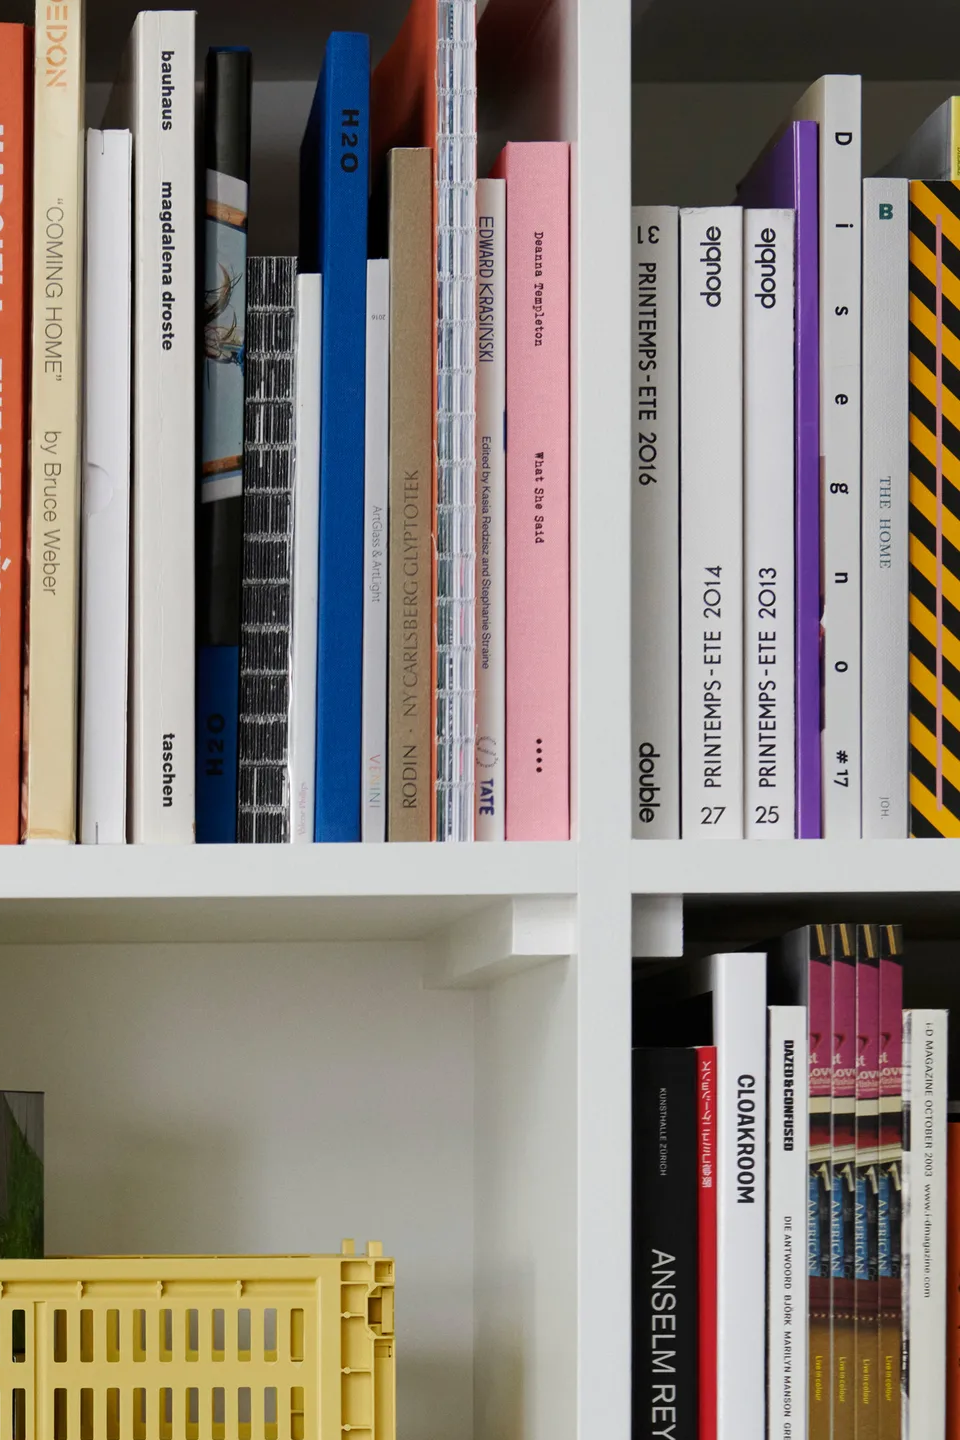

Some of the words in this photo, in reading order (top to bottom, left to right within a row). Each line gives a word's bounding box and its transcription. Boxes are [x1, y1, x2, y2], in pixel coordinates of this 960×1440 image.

[162, 51, 175, 131] bauhaus
[341, 109, 360, 173] H2O
[159, 182, 175, 286] magdalena
[479, 217, 494, 278] EDWARD
[534, 232, 544, 277] Deanna
[700, 226, 721, 308] double
[162, 290, 175, 351] droste
[533, 283, 543, 347] Templeton
[40, 431, 61, 455] by
[535, 452, 544, 483] What
[638, 432, 657, 486] 2016
[43, 463, 61, 522] Bruce
[535, 490, 544, 510] She
[535, 516, 544, 544] Said
[43, 529, 61, 596] Weber
[704, 565, 722, 619] 2014
[163, 733, 175, 808] taschen
[479, 779, 495, 816] TATE
[639, 742, 661, 823] double
[700, 807, 726, 825] 27
[784, 1040, 794, 1151] DAZED&CONFUSED
[924, 1040, 934, 1096] MAGAZINE
[737, 1074, 756, 1203] CLOAKROOM
[924, 1100, 934, 1149] OCTOBER
[924, 1153, 933, 1177] 2003
[651, 1249, 676, 1373] ANSELM
